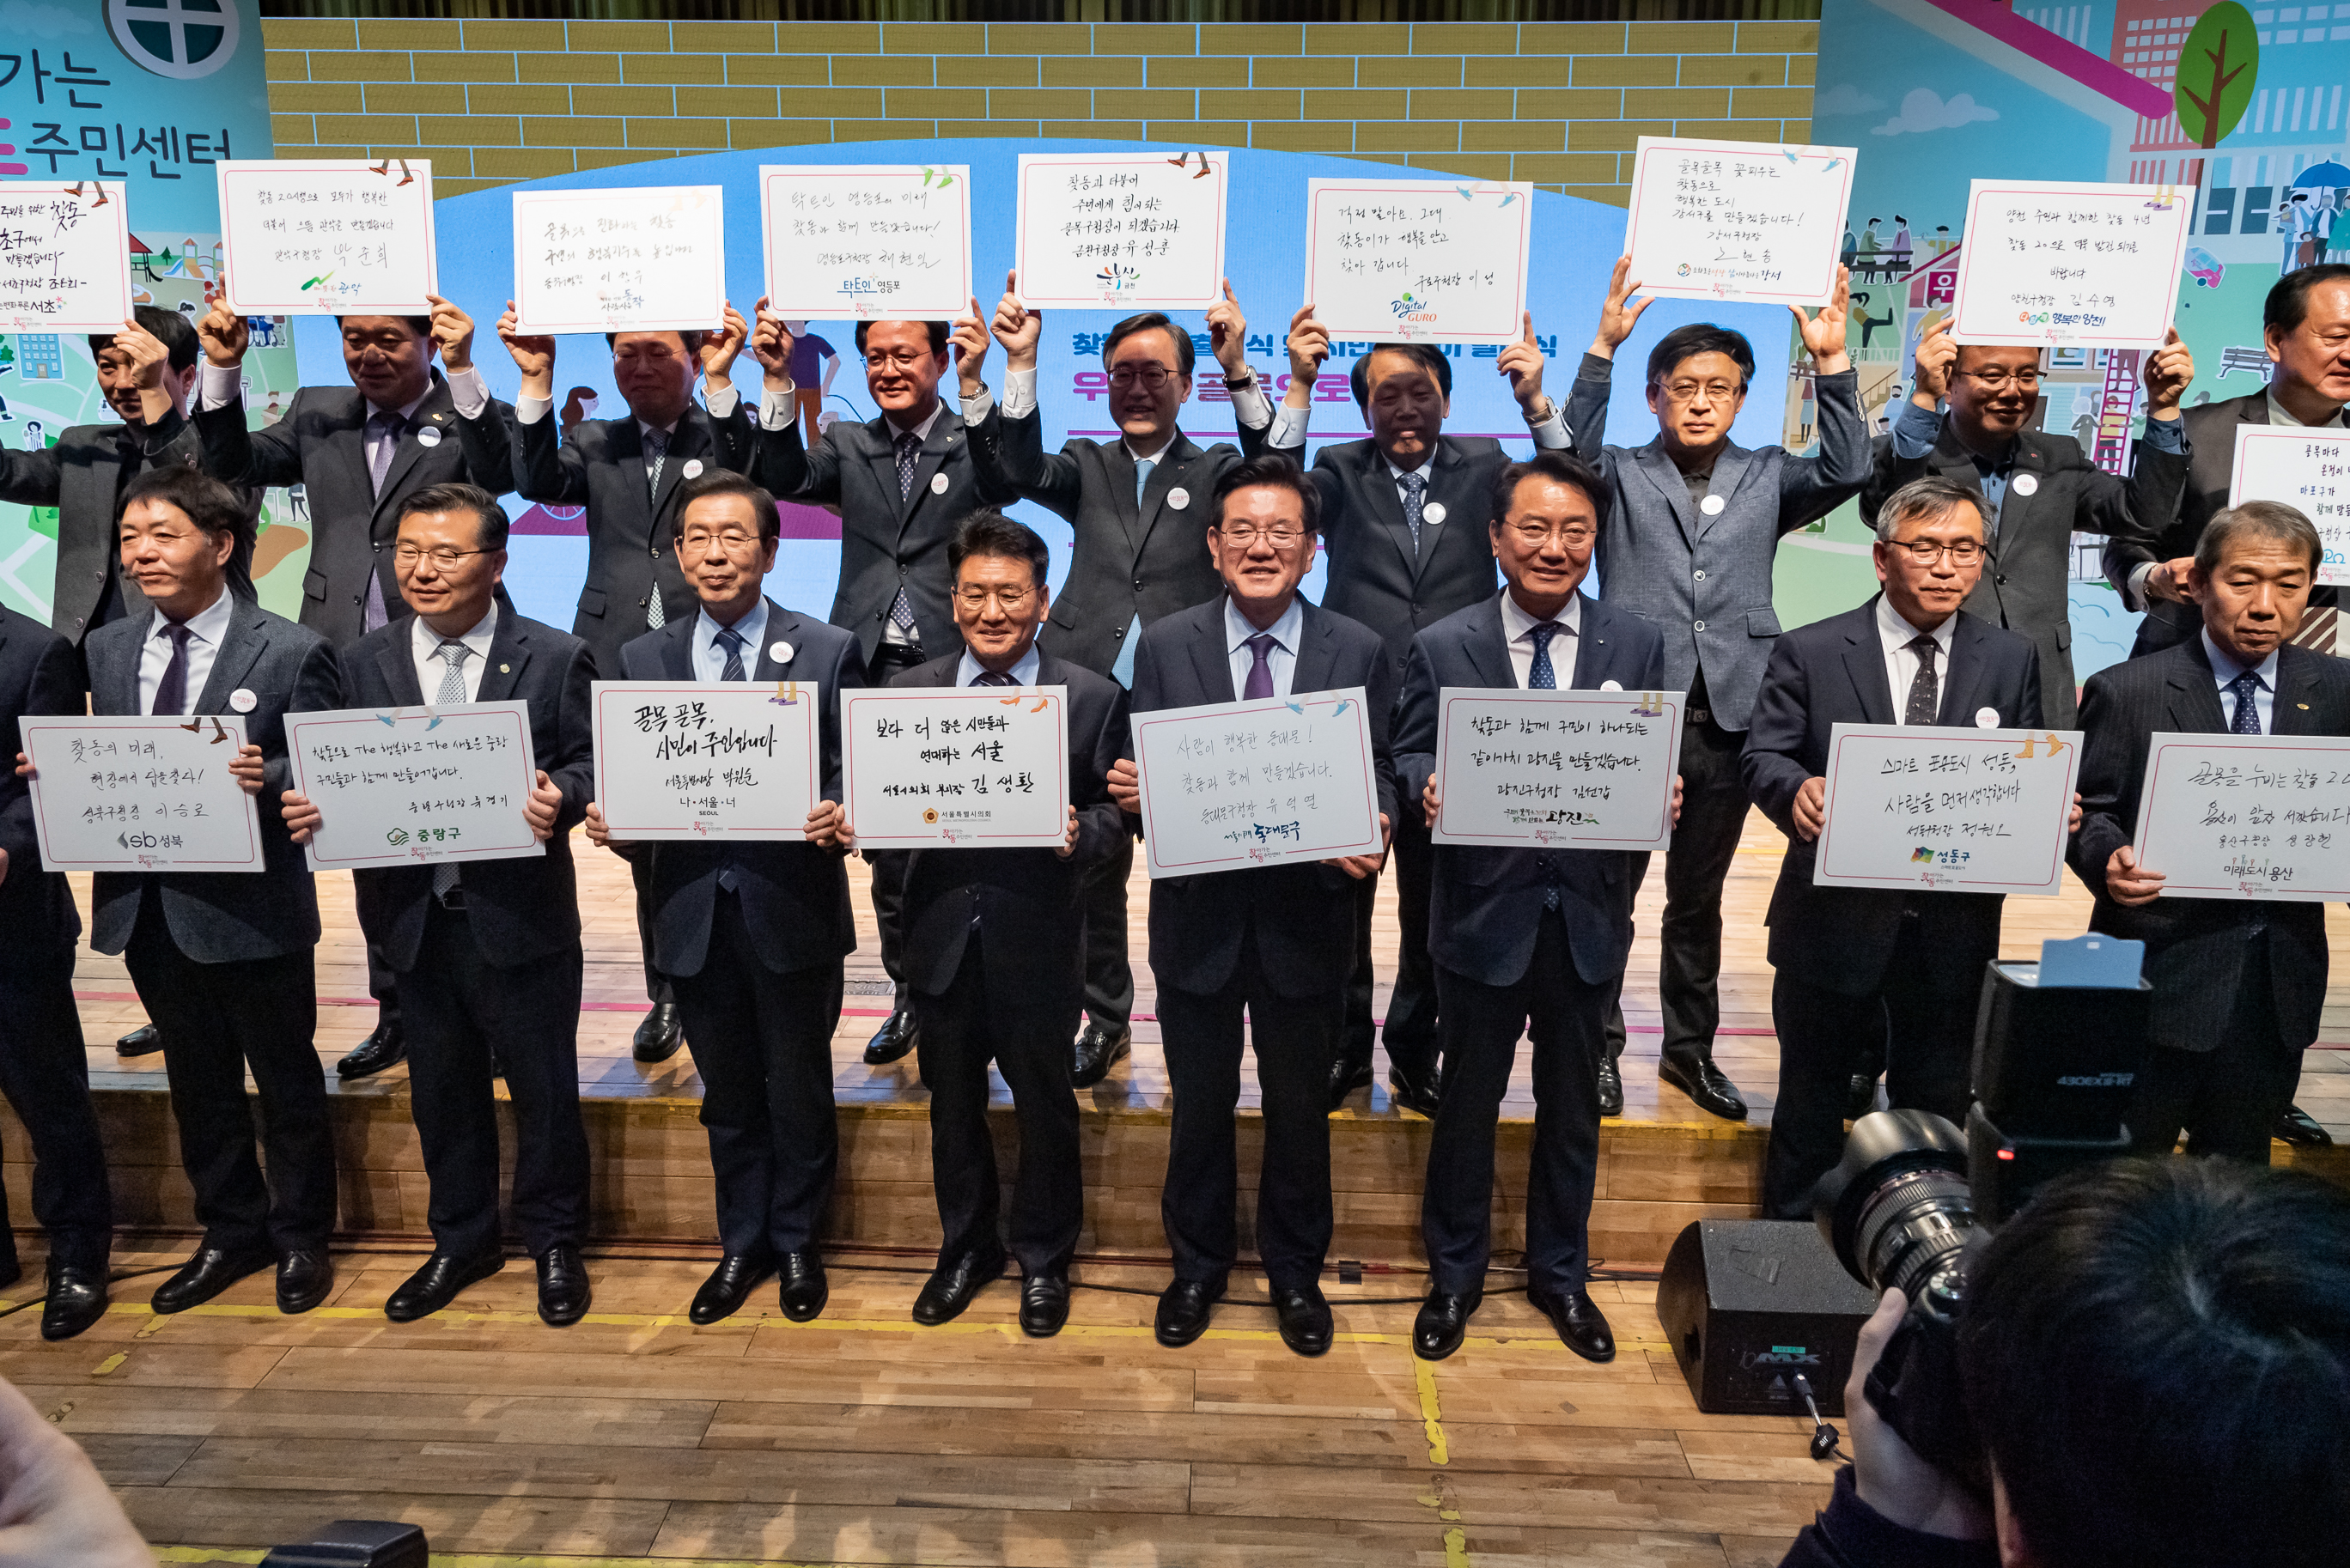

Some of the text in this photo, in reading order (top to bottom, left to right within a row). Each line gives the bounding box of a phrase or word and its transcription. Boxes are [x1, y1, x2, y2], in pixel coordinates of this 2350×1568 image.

[1714, 198, 1734, 207] 도시
[878, 281, 900, 293] 영등포
[31, 300, 56, 313] 서초
[1407, 313, 1437, 321] GURO
[634, 706, 667, 732] 골목
[971, 740, 1003, 762] 서울
[159, 835, 183, 848] 성북
[417, 828, 461, 842] 중랑구
[1937, 849, 1969, 863] 성동구
